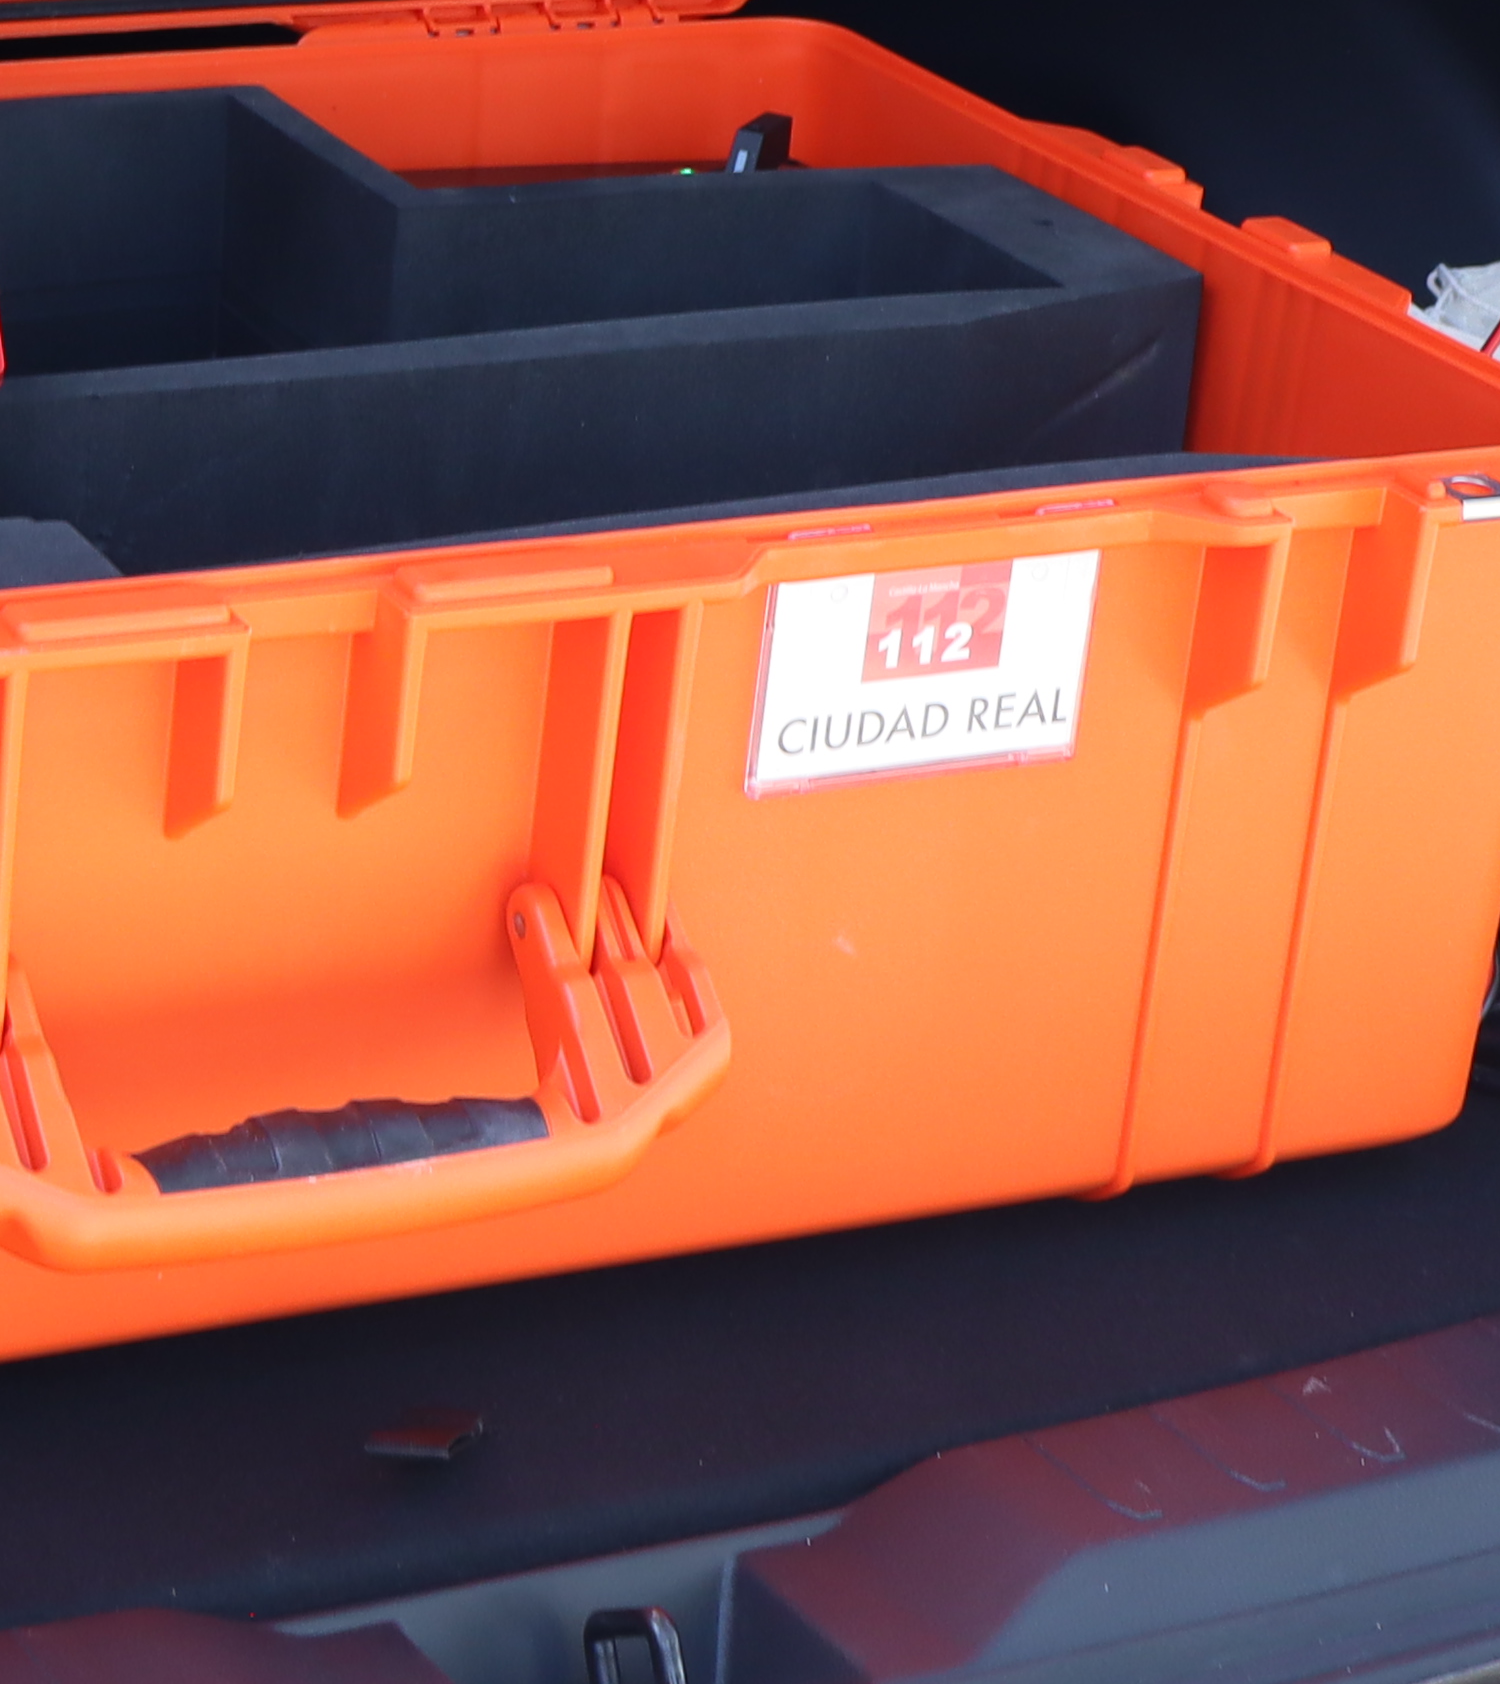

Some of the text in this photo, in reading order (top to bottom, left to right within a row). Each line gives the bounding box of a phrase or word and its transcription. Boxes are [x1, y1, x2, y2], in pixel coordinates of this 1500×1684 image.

[877, 622, 973, 669] 112
[777, 687, 1067, 755] CIUDAD REAL
